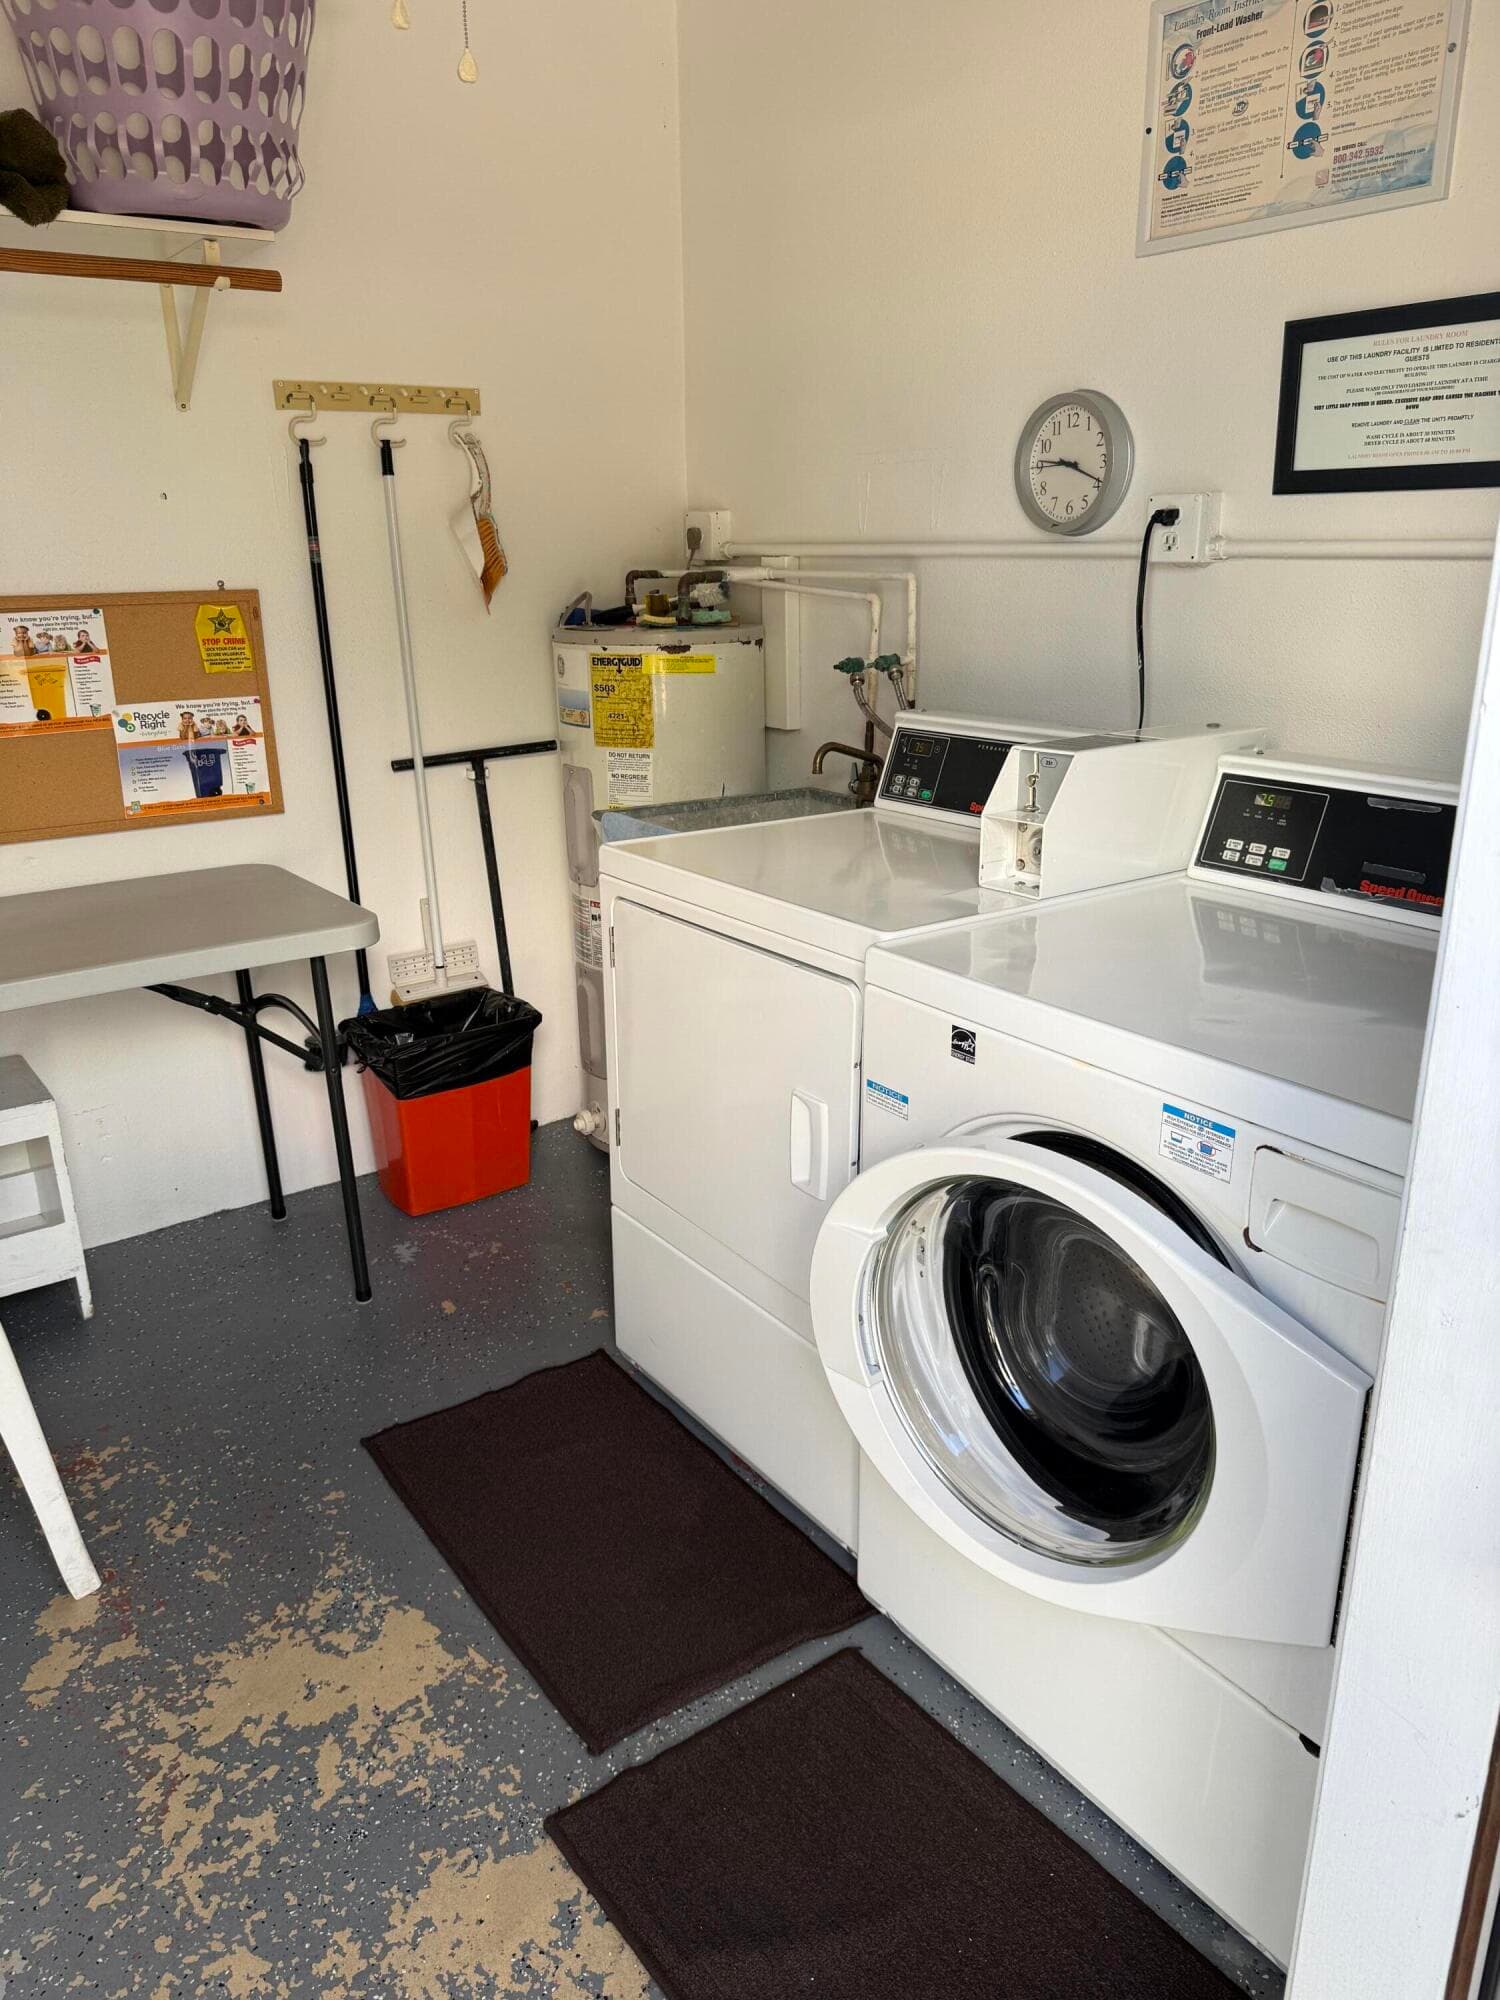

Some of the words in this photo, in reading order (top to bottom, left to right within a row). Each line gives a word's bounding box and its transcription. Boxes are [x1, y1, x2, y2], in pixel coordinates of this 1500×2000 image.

[1174, 12, 1205, 31] Laundry
[1208, 6, 1231, 20] Room
[1196, 19, 1234, 40] Front-Load
[1235, 10, 1264, 27] Washer
[1410, 333, 1443, 342] LAUNDRY
[1445, 330, 1469, 338] ROOM
[1364, 350, 1392, 359] LAUNDRY
[1393, 347, 1420, 355] FACILITY
[1405, 354, 1430, 362] GUESTS
[1434, 378, 1460, 386] LAUNDRY
[1067, 412, 1080, 428] 12
[1087, 416, 1091, 431] 1
[1052, 421, 1061, 436] 11
[1041, 438, 1052, 454] 10
[1096, 431, 1104, 447] 2
[1036, 461, 1043, 475] 9
[1099, 453, 1107, 469] 3
[1040, 481, 1047, 496] 8
[1092, 477, 1101, 491] 4
[1051, 496, 1058, 511] 7
[1065, 499, 1074, 515] 6
[1081, 494, 1089, 510] 5
[60, 613, 80, 621] trying,
[223, 637, 246, 645] CRIME
[593, 684, 615, 693] $503
[133, 710, 170, 721] Recycle
[140, 720, 166, 730] Right
[1360, 879, 1406, 898] Speed
[872, 1082, 903, 1100] NOTICE
[1183, 1112, 1214, 1128] NOTICE
